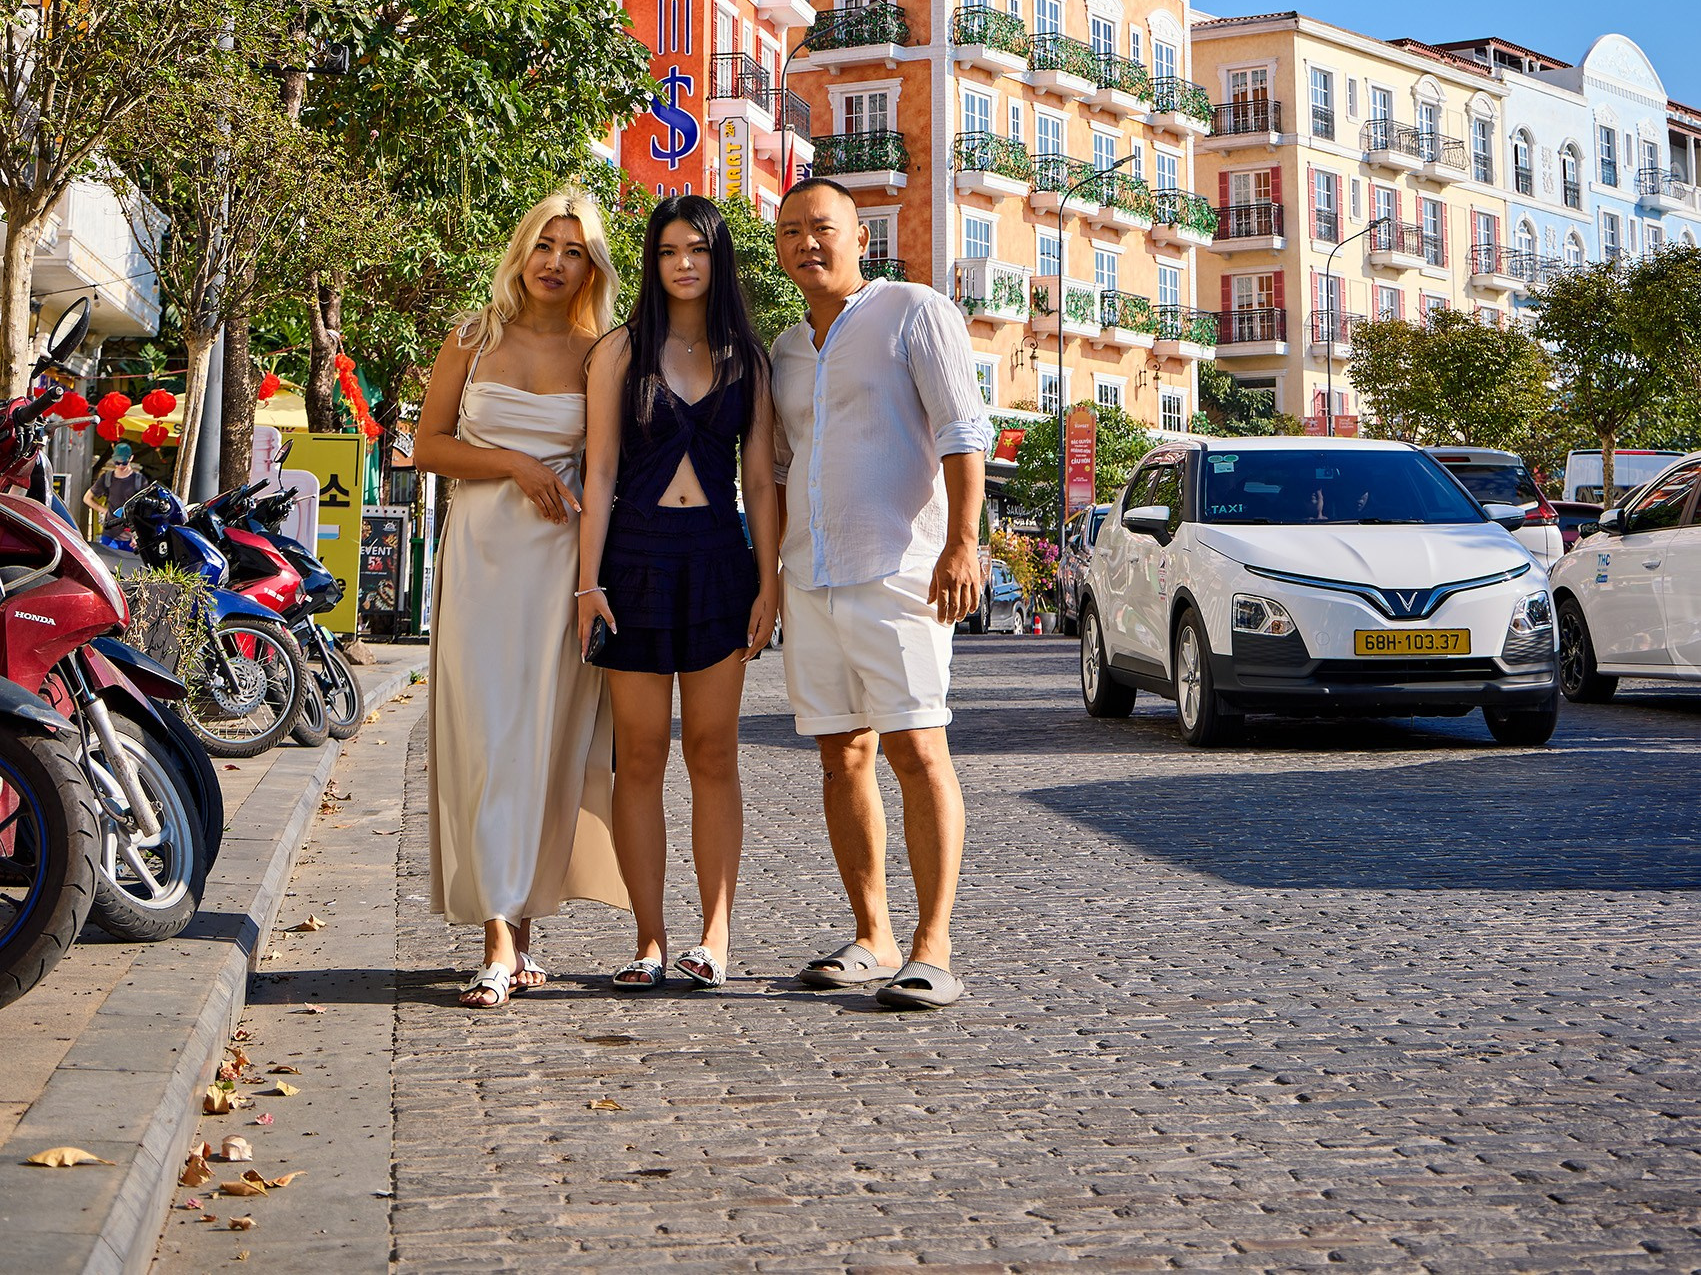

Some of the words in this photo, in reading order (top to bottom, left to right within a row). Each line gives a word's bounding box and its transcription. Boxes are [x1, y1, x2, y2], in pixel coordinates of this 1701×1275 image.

[1211, 504, 1243, 515] TAXI
[360, 546, 392, 556] EVENT
[15, 611, 56, 626] HONDA
[1365, 634, 1460, 650] 68H-103.37
